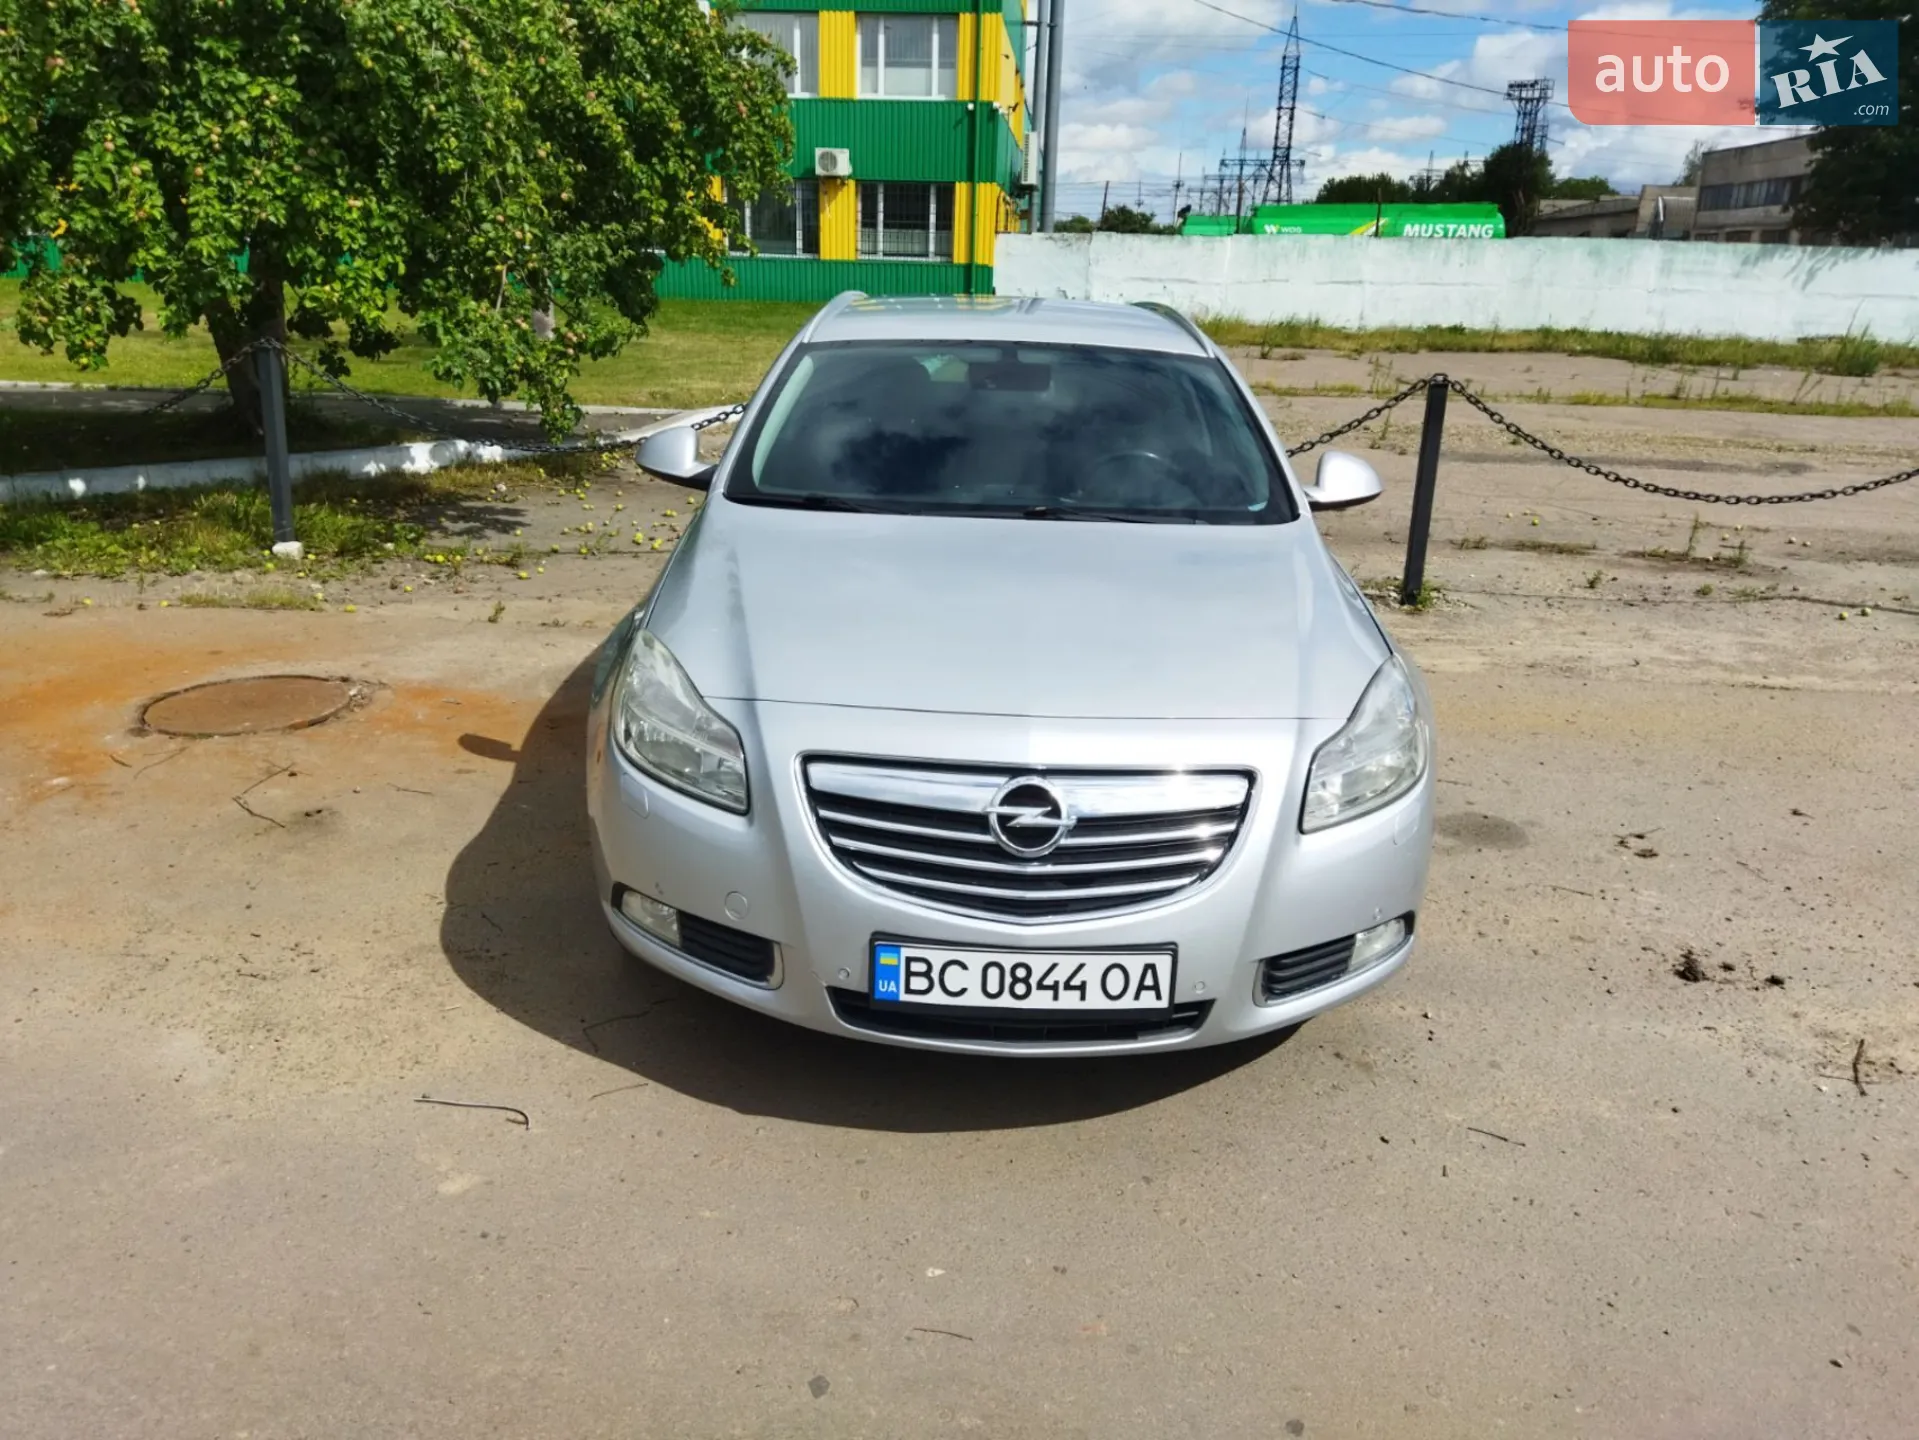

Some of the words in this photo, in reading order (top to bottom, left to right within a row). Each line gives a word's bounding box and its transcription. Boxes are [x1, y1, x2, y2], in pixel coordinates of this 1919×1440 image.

[1403, 223, 1495, 238] MUSTANG
[878, 979, 898, 994] UA
[904, 956, 969, 998] BC
[980, 961, 1088, 1002] 0844
[1100, 962, 1163, 1002] OA
